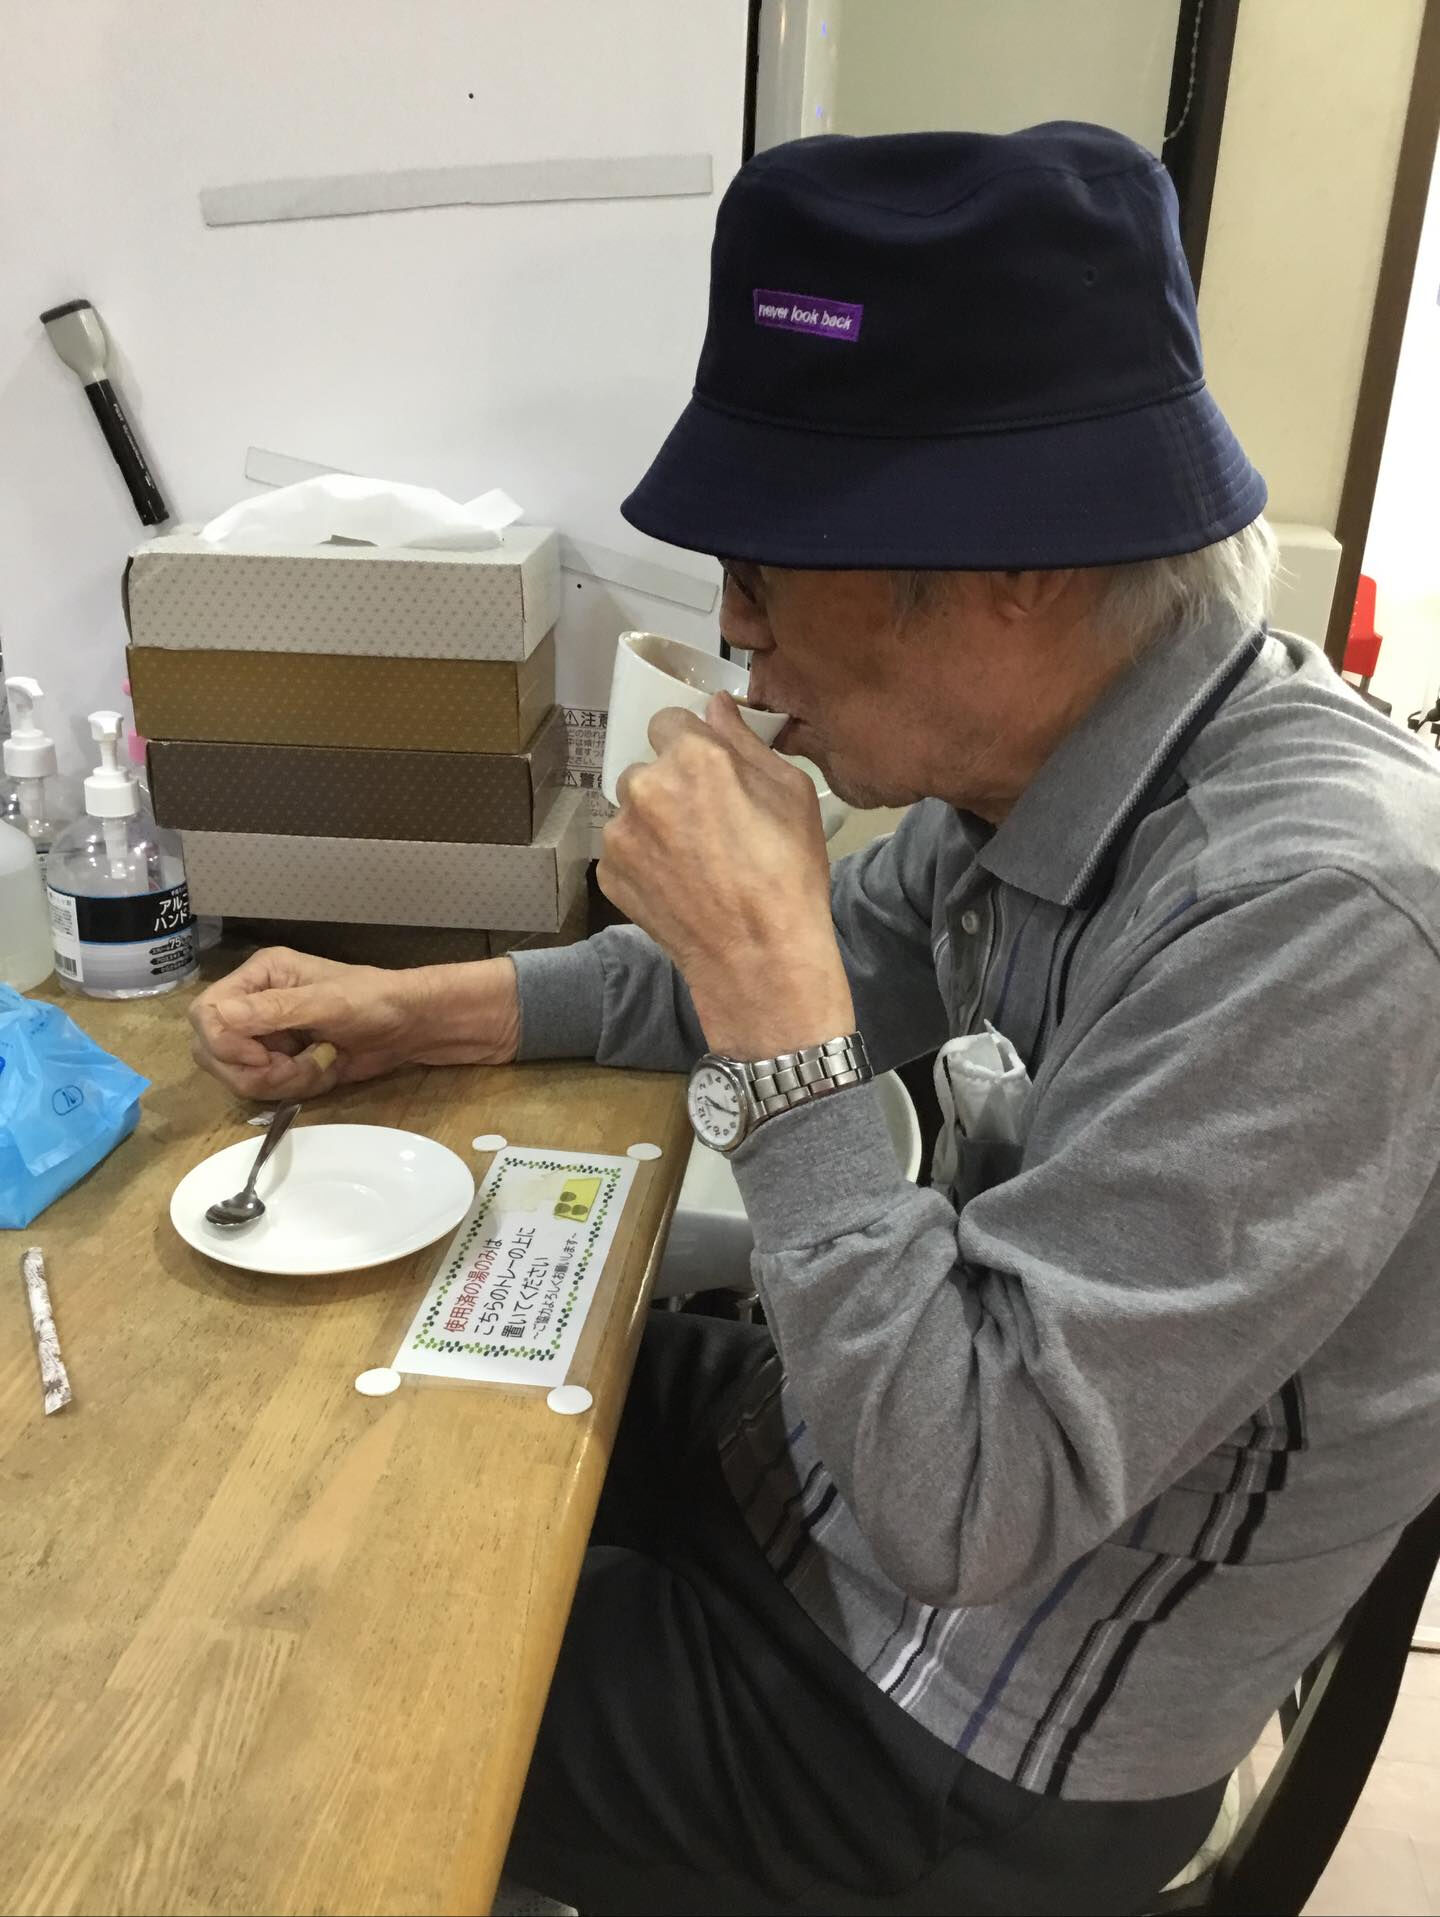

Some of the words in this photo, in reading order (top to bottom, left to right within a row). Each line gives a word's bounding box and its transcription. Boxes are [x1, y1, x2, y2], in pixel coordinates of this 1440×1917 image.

[758, 304, 789, 319] never
[790, 305, 819, 325] look
[820, 310, 853, 330] back
[443, 1238, 503, 1333] 使用済の湯のみは
[474, 1227, 536, 1336] こちらのトレーの上に
[501, 1257, 550, 1338] 置いてください
